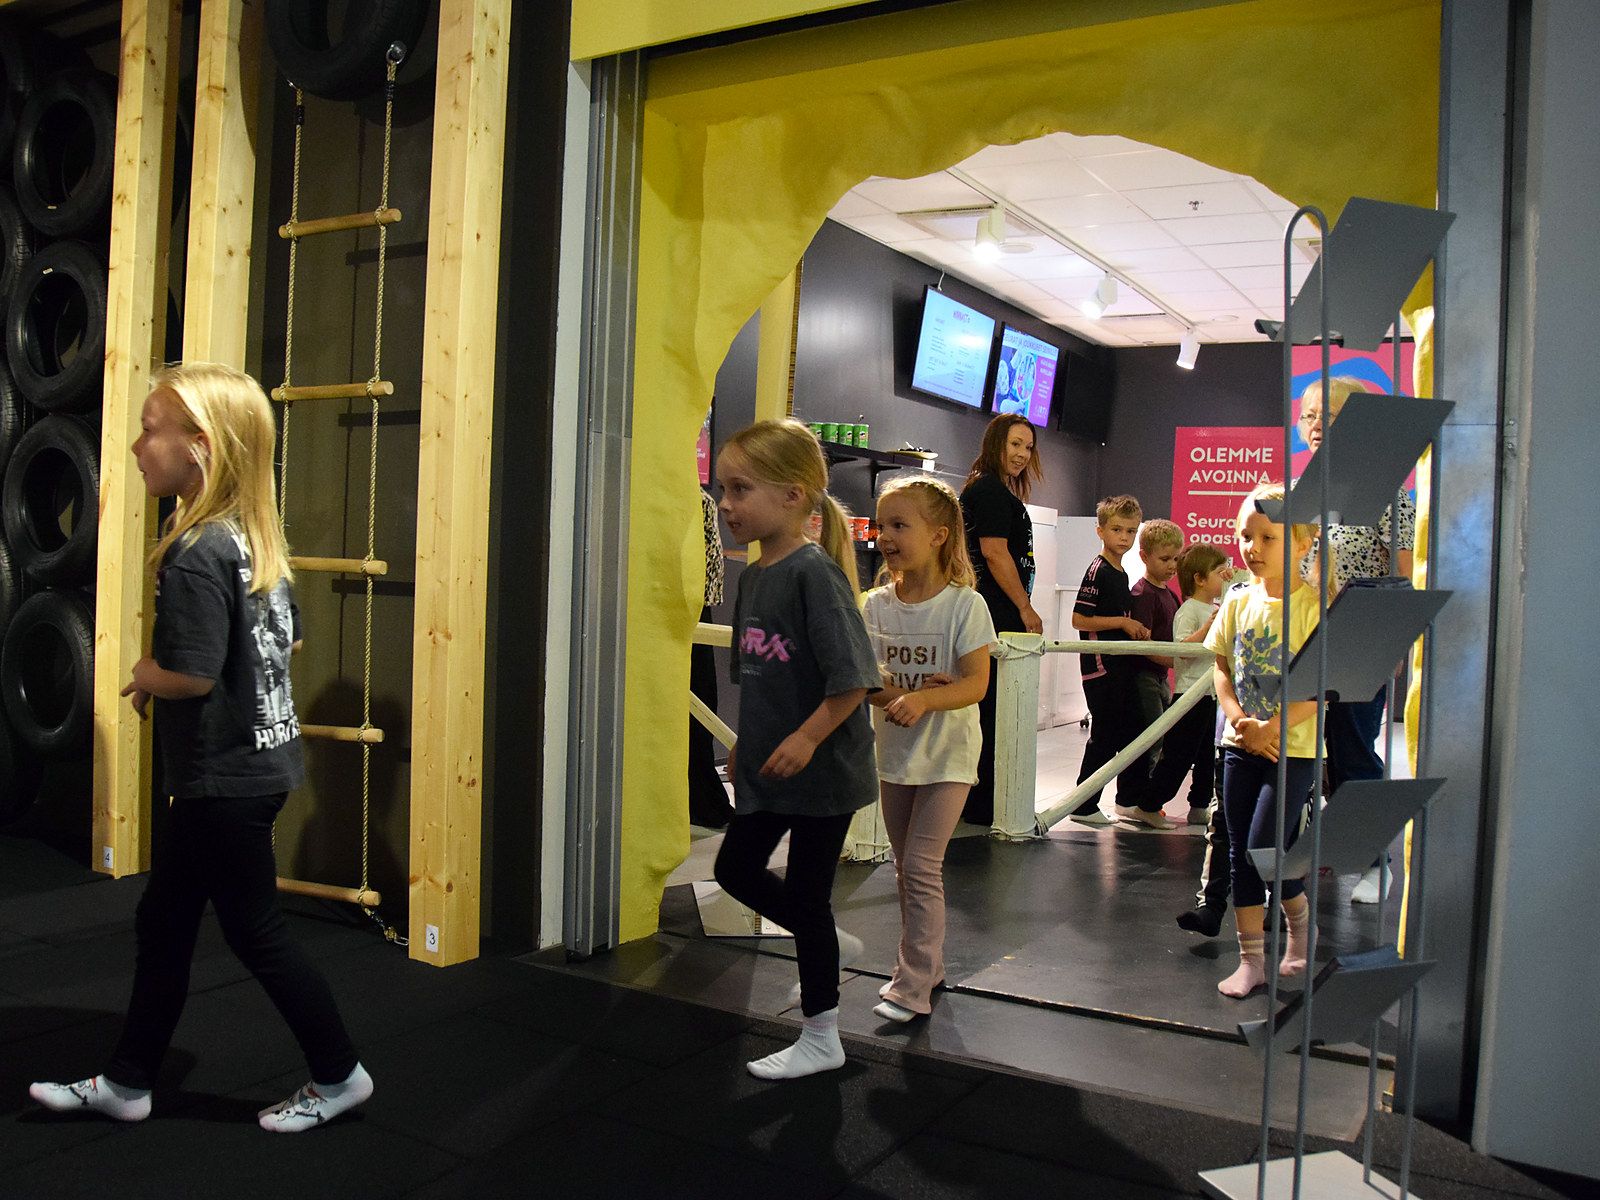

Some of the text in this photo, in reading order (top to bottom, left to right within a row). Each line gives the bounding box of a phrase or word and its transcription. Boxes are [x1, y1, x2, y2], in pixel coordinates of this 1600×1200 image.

[1190, 447, 1273, 463] OLEMME
[1189, 469, 1270, 484] AVOINNA
[1186, 512, 1237, 529] Seura
[887, 645, 936, 666] POSI
[105, 852, 111, 863] 4
[429, 932, 436, 945] 3
